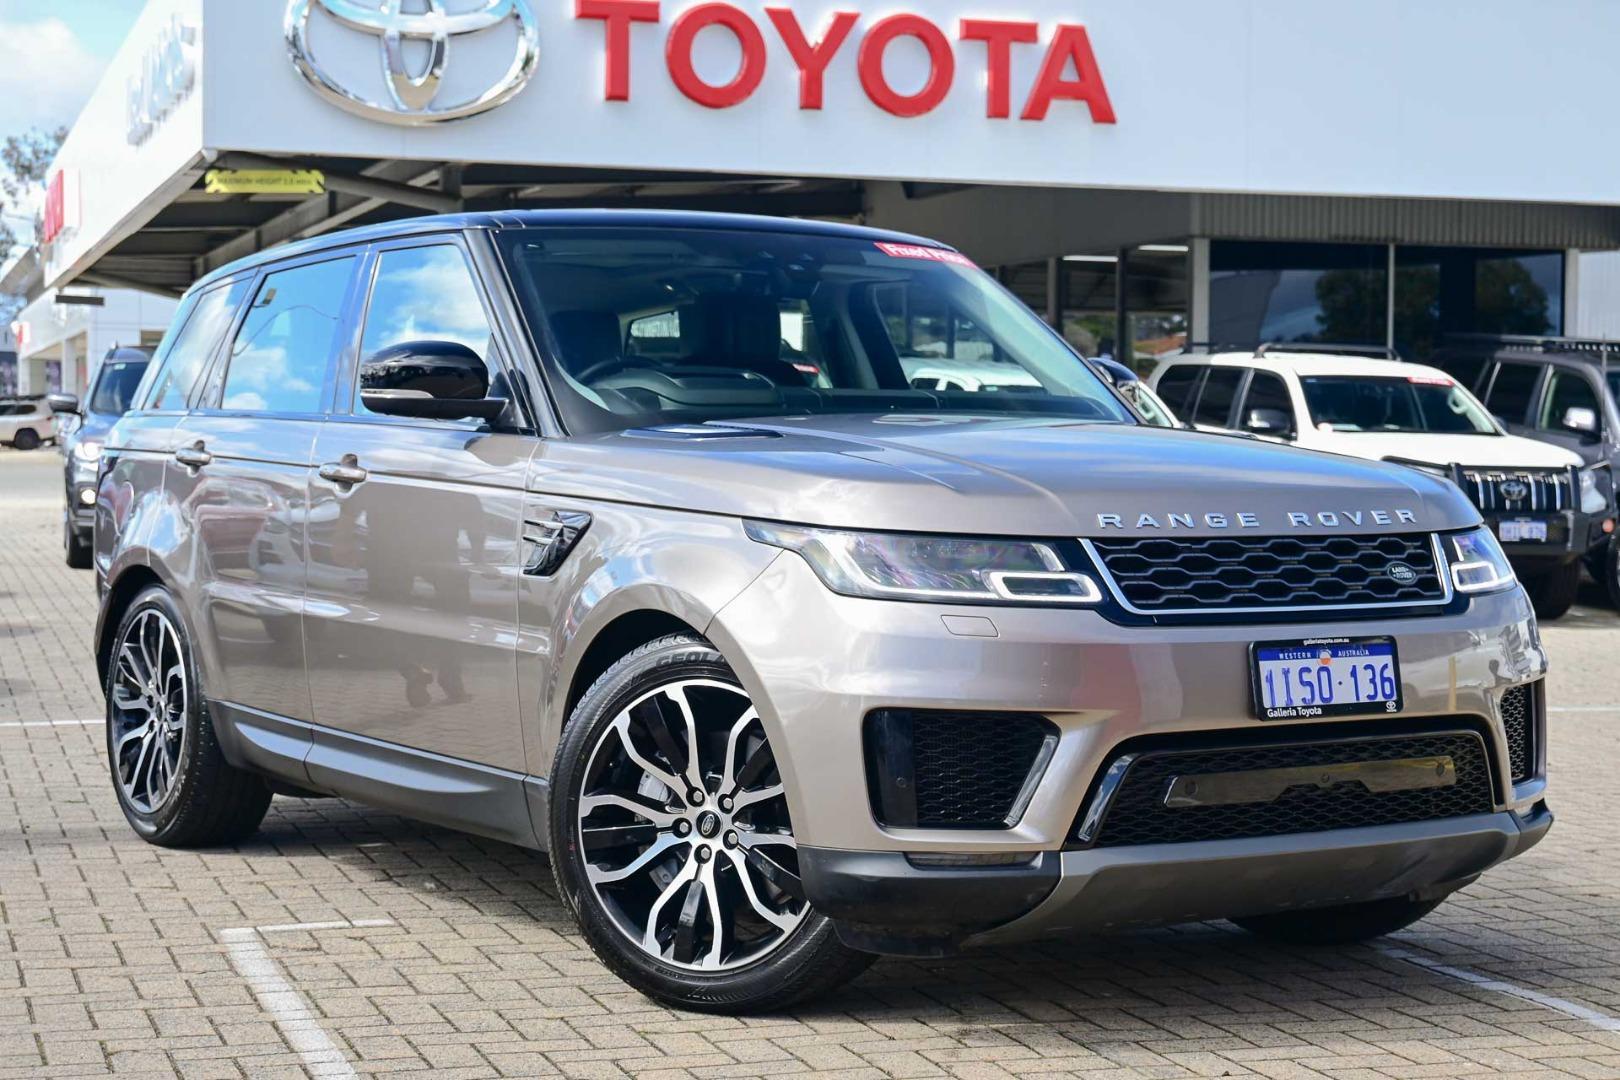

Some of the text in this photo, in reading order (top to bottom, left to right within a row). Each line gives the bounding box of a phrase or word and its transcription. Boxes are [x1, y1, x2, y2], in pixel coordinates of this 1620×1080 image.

[575, 0, 1117, 124] TOYOTA
[1097, 509, 1417, 528] RANGE ROVER
[1279, 649, 1370, 660] WESTERN AUSTRALIA
[1266, 706, 1323, 718] Galleria Toyota
